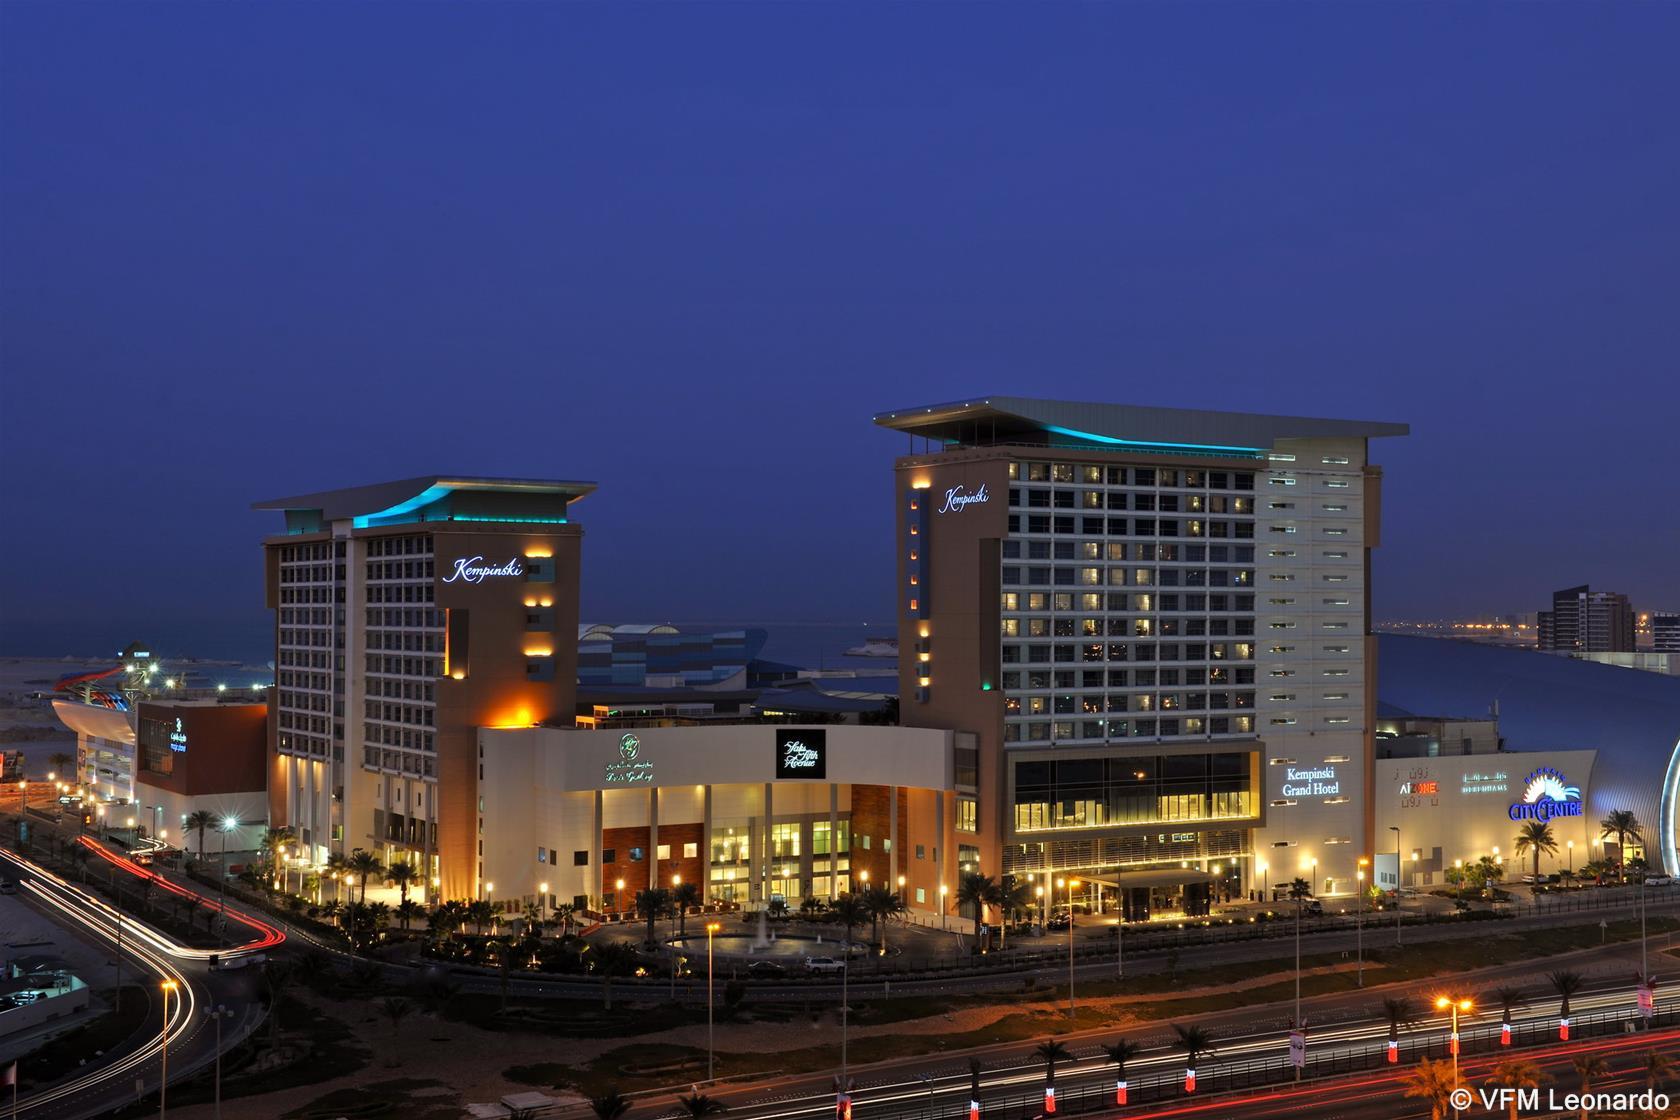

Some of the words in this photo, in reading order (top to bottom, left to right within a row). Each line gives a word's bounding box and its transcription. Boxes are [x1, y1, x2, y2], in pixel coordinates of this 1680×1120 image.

[938, 483, 990, 514] Kempinski
[442, 556, 523, 584] Kempinski
[1287, 766, 1335, 782] Kempinski
[1282, 783, 1311, 797] Grand
[1313, 781, 1339, 795] Hotel
